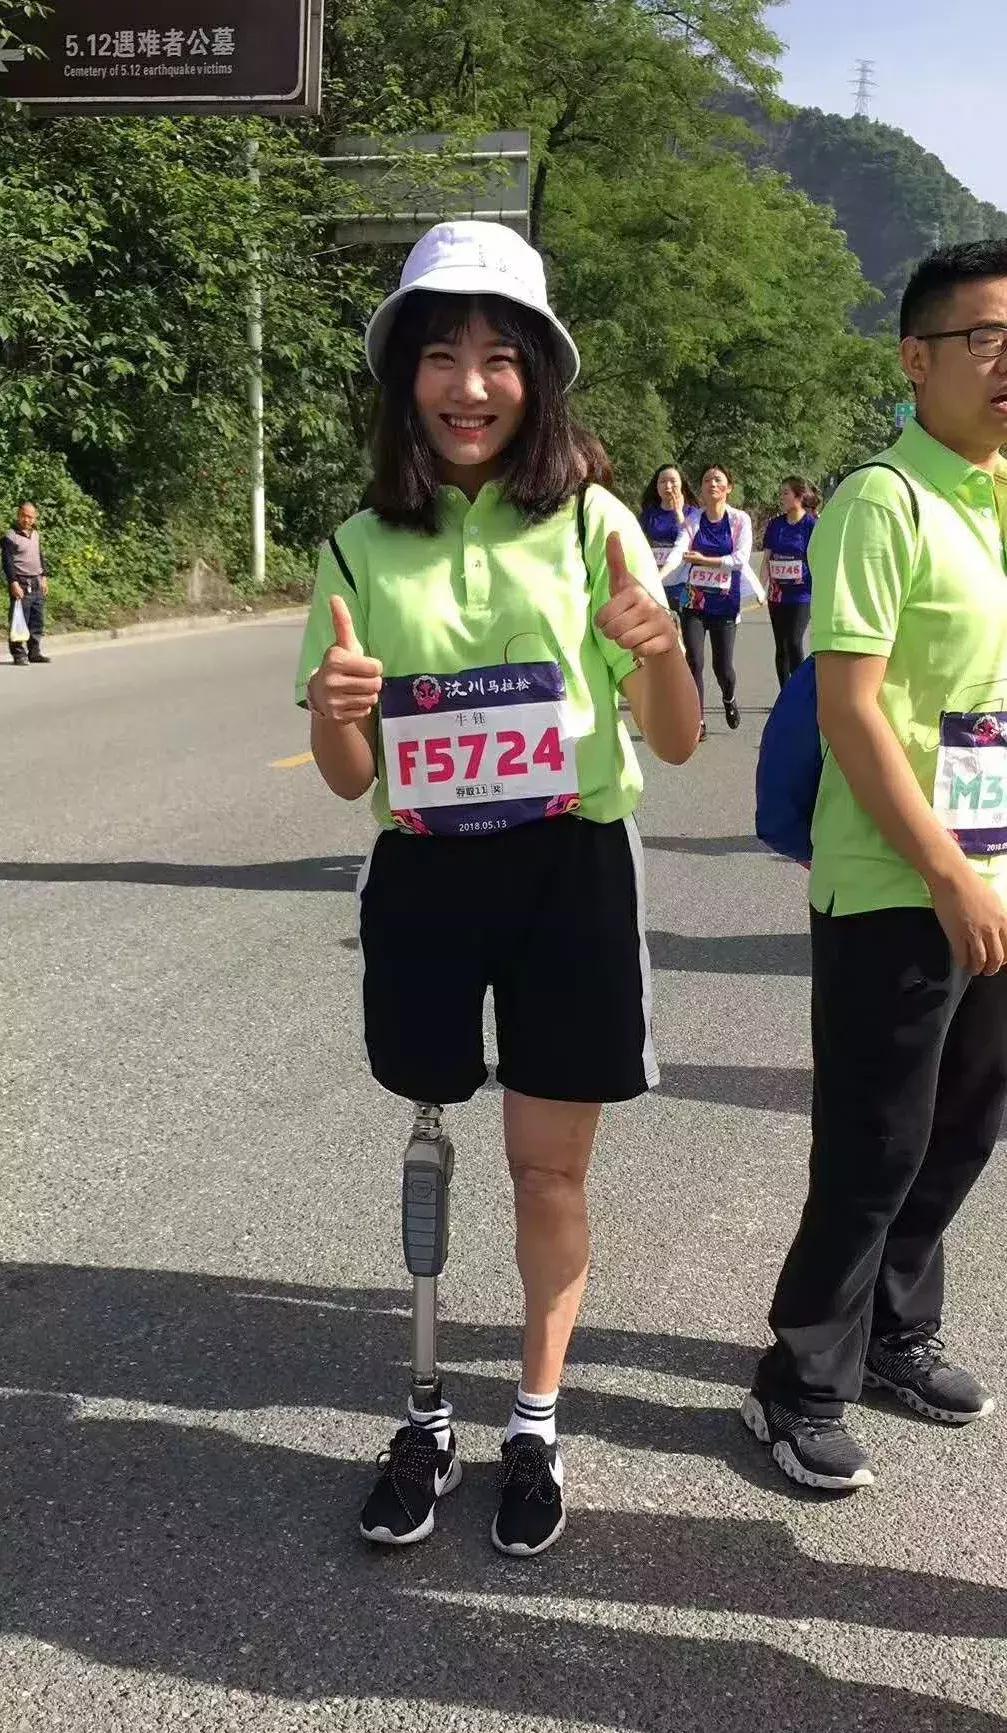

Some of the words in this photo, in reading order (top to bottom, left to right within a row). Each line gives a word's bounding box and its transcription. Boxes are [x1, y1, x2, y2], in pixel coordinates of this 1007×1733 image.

[65, 27, 236, 58] 5.12遇难者公墓
[63, 65, 107, 78] Cemetery
[109, 64, 119, 76] of
[120, 64, 141, 76] 5.12
[143, 63, 196, 77] earthquake
[196, 62, 233, 74] victims
[692, 571, 728, 583] F5745
[444, 677, 531, 698] 汶川马拉松
[398, 727, 565, 786] F5724
[949, 772, 1007, 810] M3
[459, 819, 507, 832] 2018.05.13
